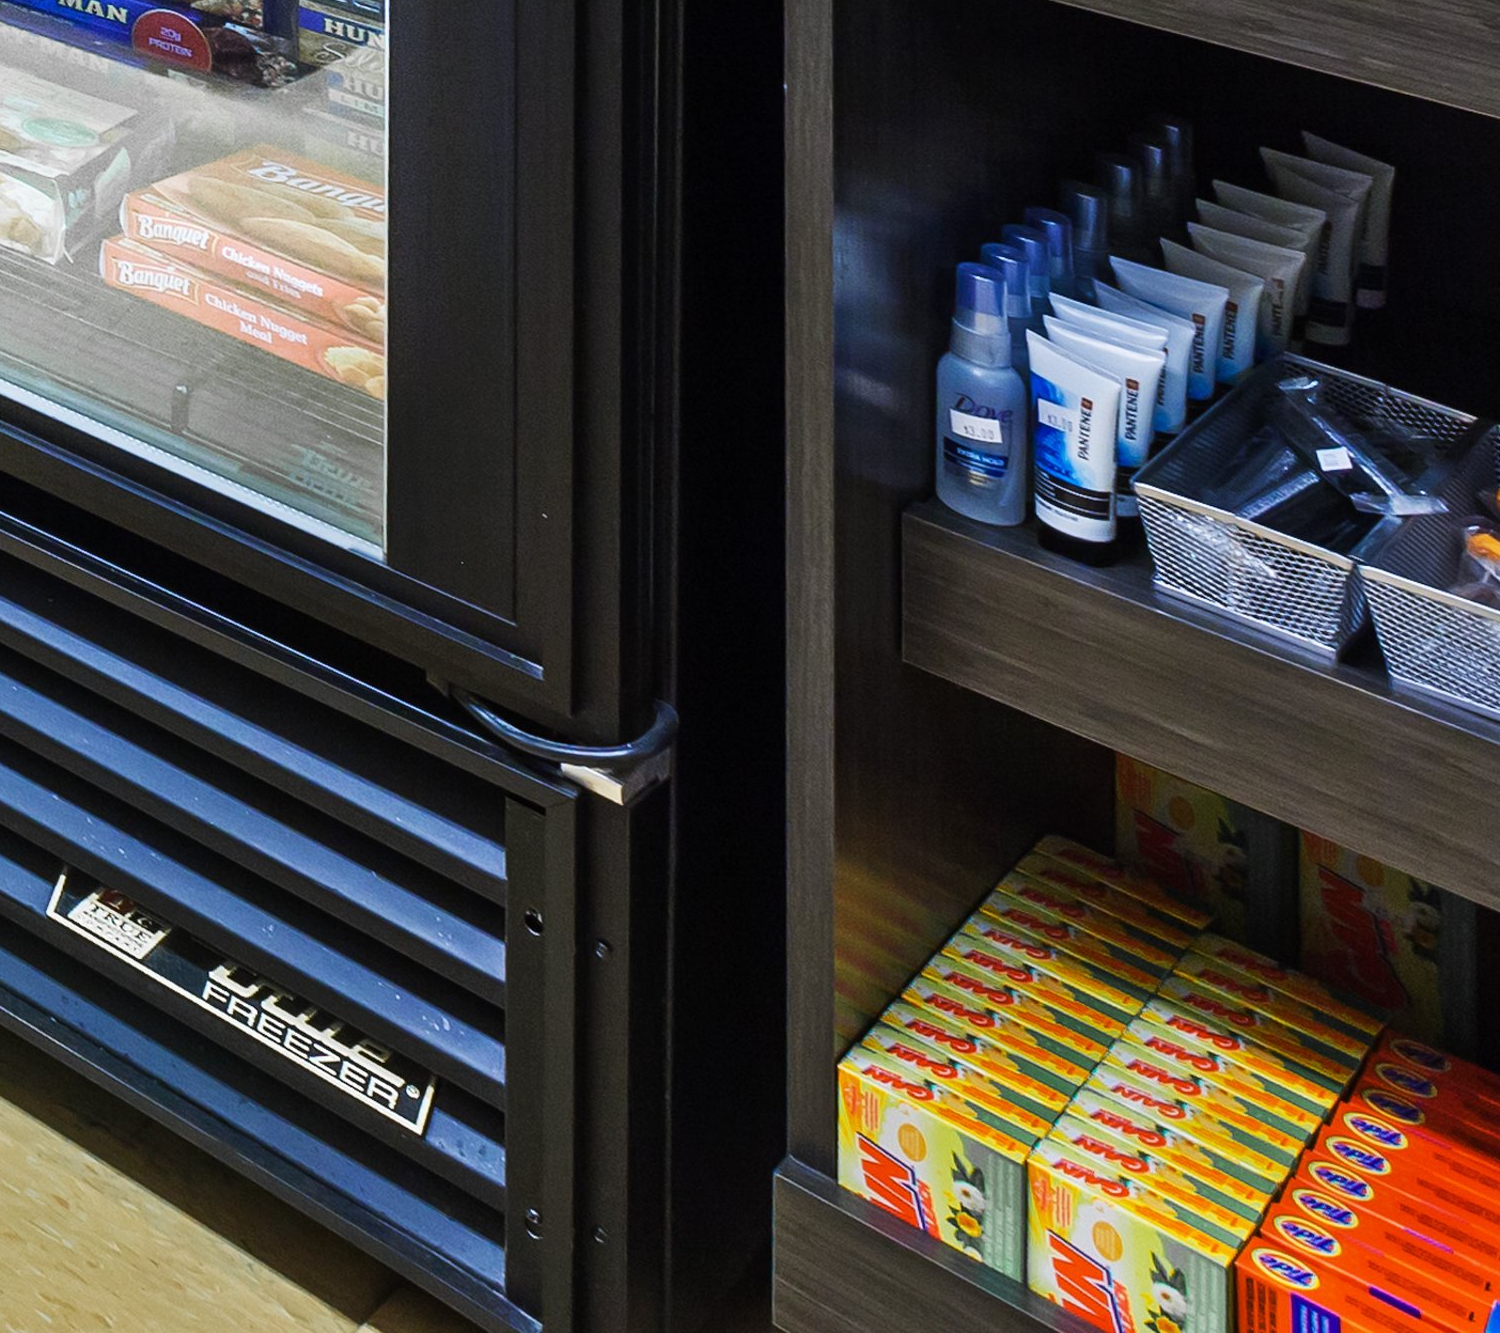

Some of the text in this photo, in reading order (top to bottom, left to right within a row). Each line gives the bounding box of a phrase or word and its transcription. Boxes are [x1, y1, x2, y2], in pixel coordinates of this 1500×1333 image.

[148, 37, 193, 58] PROTEIN
[137, 214, 210, 250] Banquet
[117, 260, 190, 296] Banquet
[221, 245, 324, 297] Chicken Nuggets
[204, 292, 308, 345] Chicken Nugget
[239, 322, 273, 344] Meal
[1223, 312, 1237, 361] PANTENE
[1193, 323, 1205, 374] PANTENE
[954, 392, 1014, 424] Dove
[1125, 389, 1139, 441] PANTENE
[1077, 408, 1092, 461] PANTENE
[201, 980, 399, 1110] FREEZER
